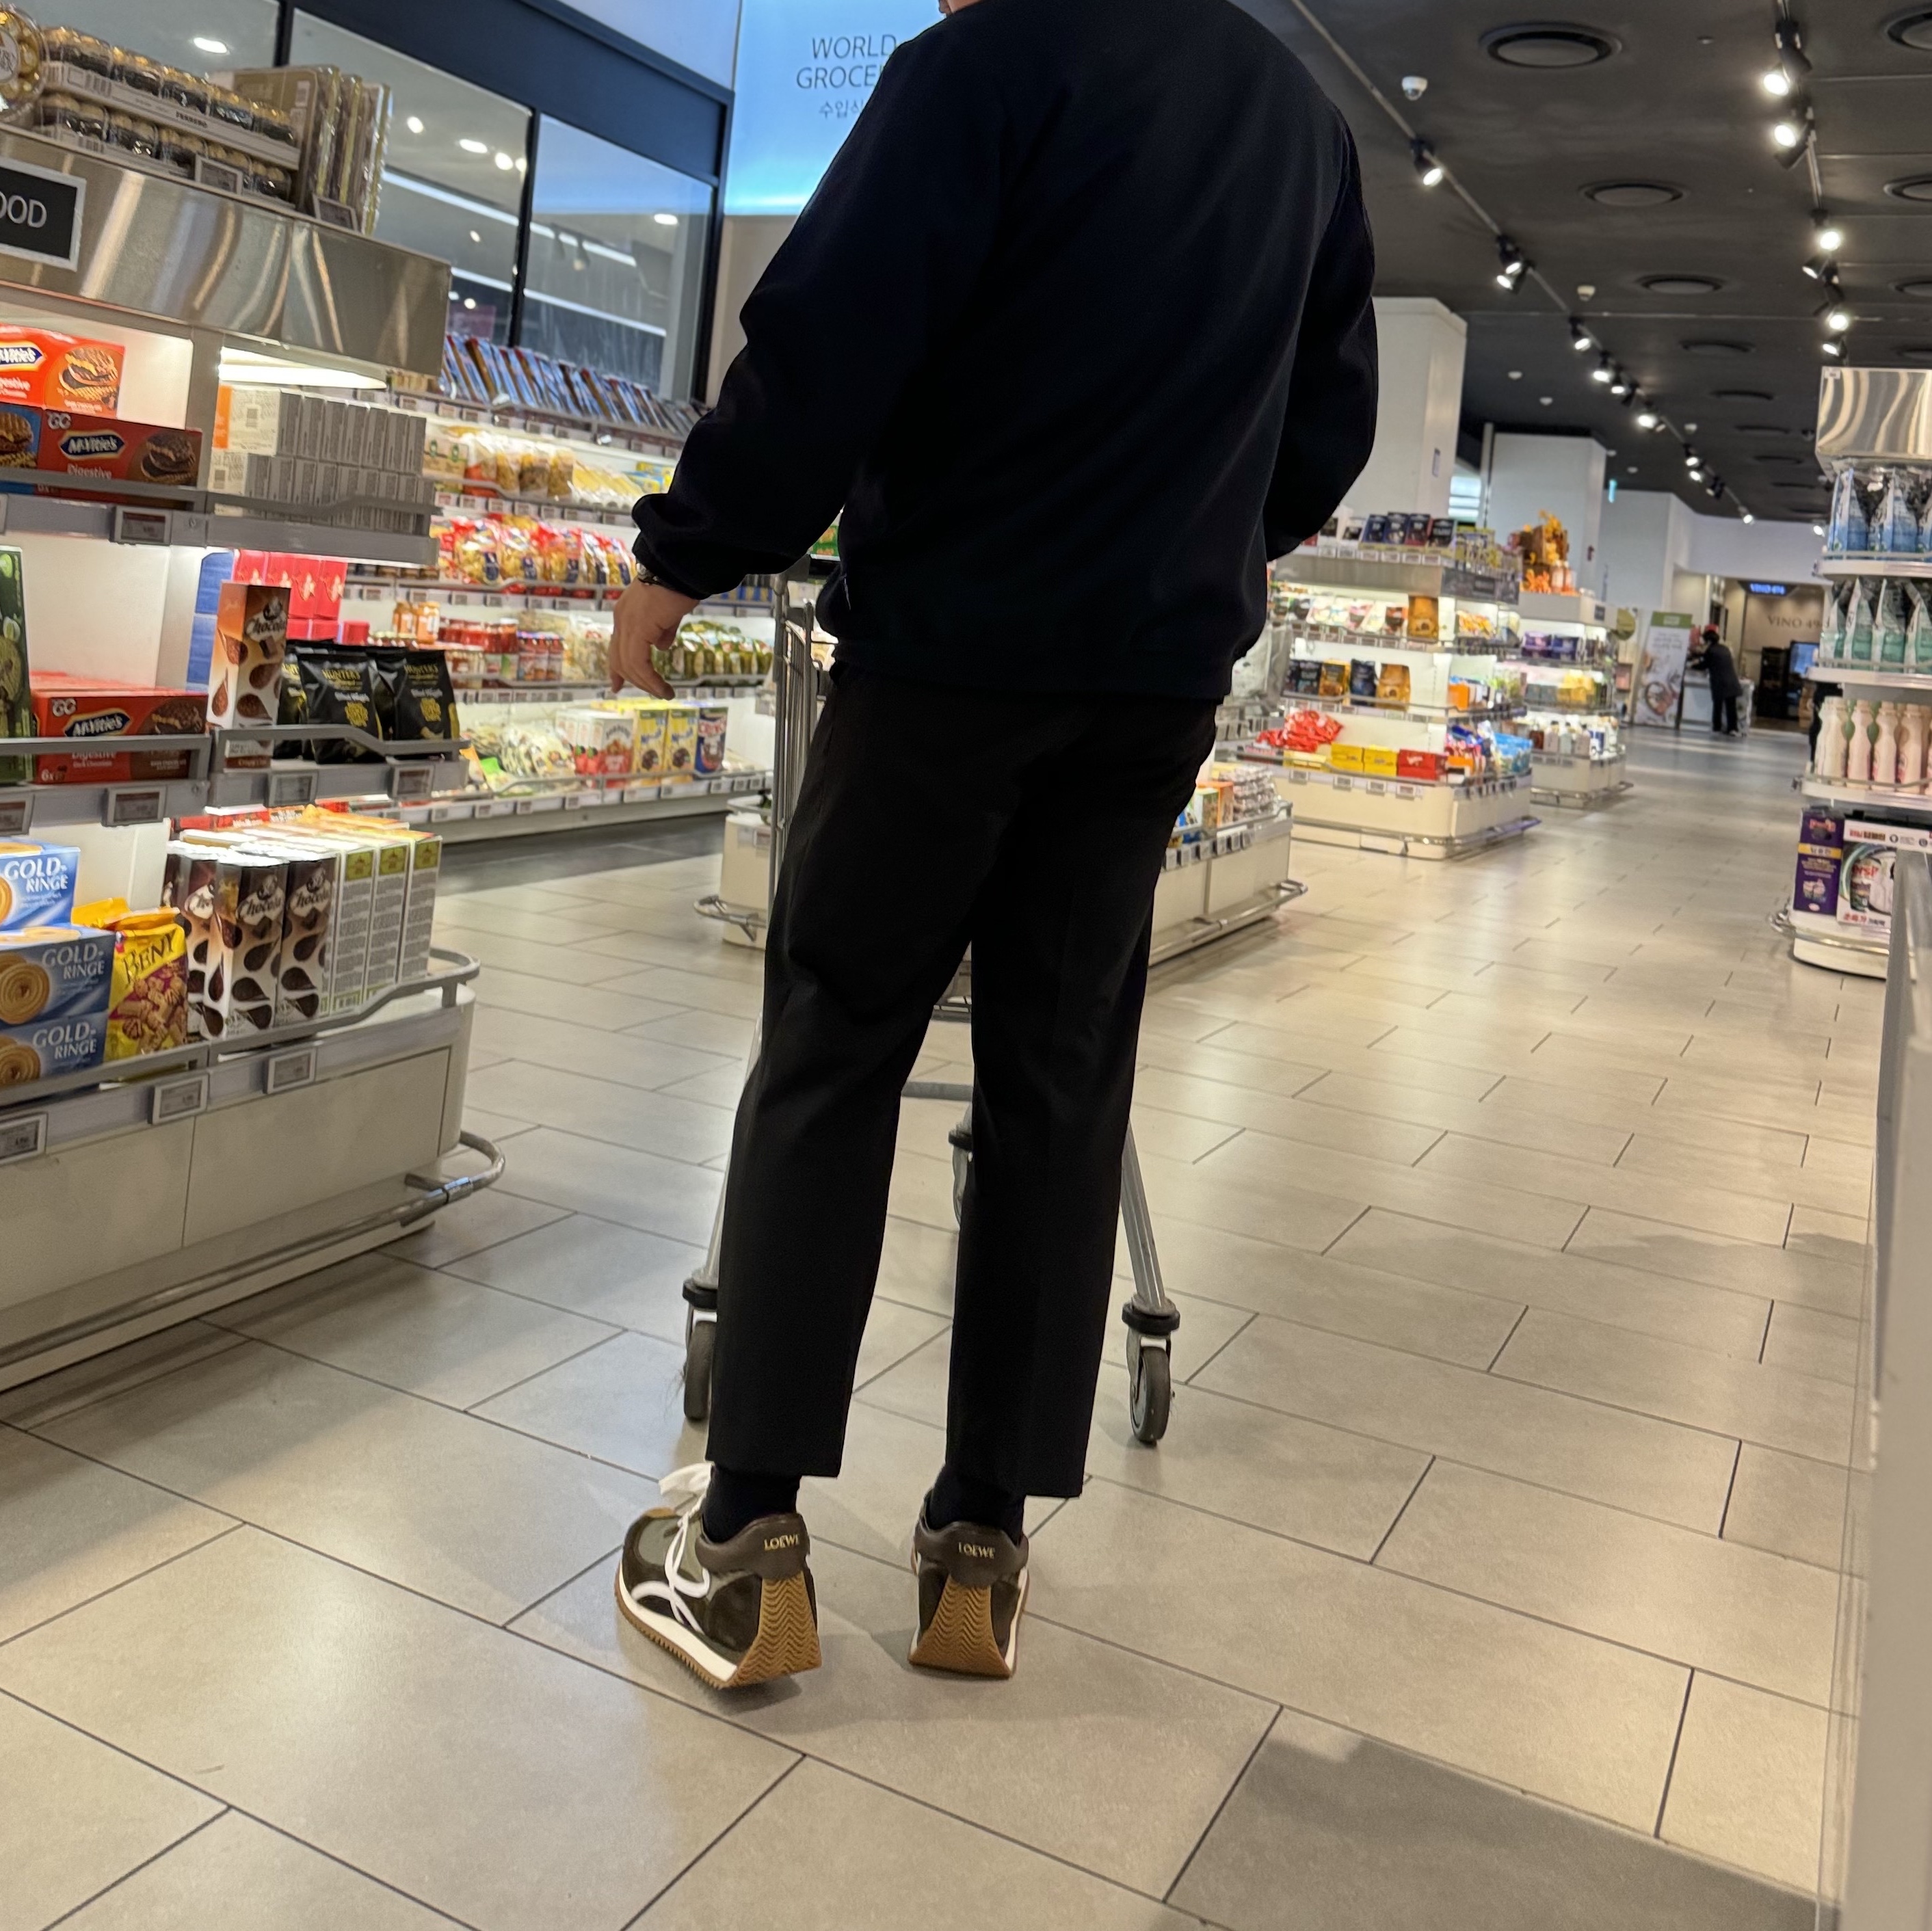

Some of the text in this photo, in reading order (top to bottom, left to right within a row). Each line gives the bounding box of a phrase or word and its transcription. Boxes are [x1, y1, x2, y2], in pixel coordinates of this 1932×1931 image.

[812, 34, 897, 59] WORLD
[796, 64, 885, 90] GROCE
[1767, 615, 1803, 628] VINO
